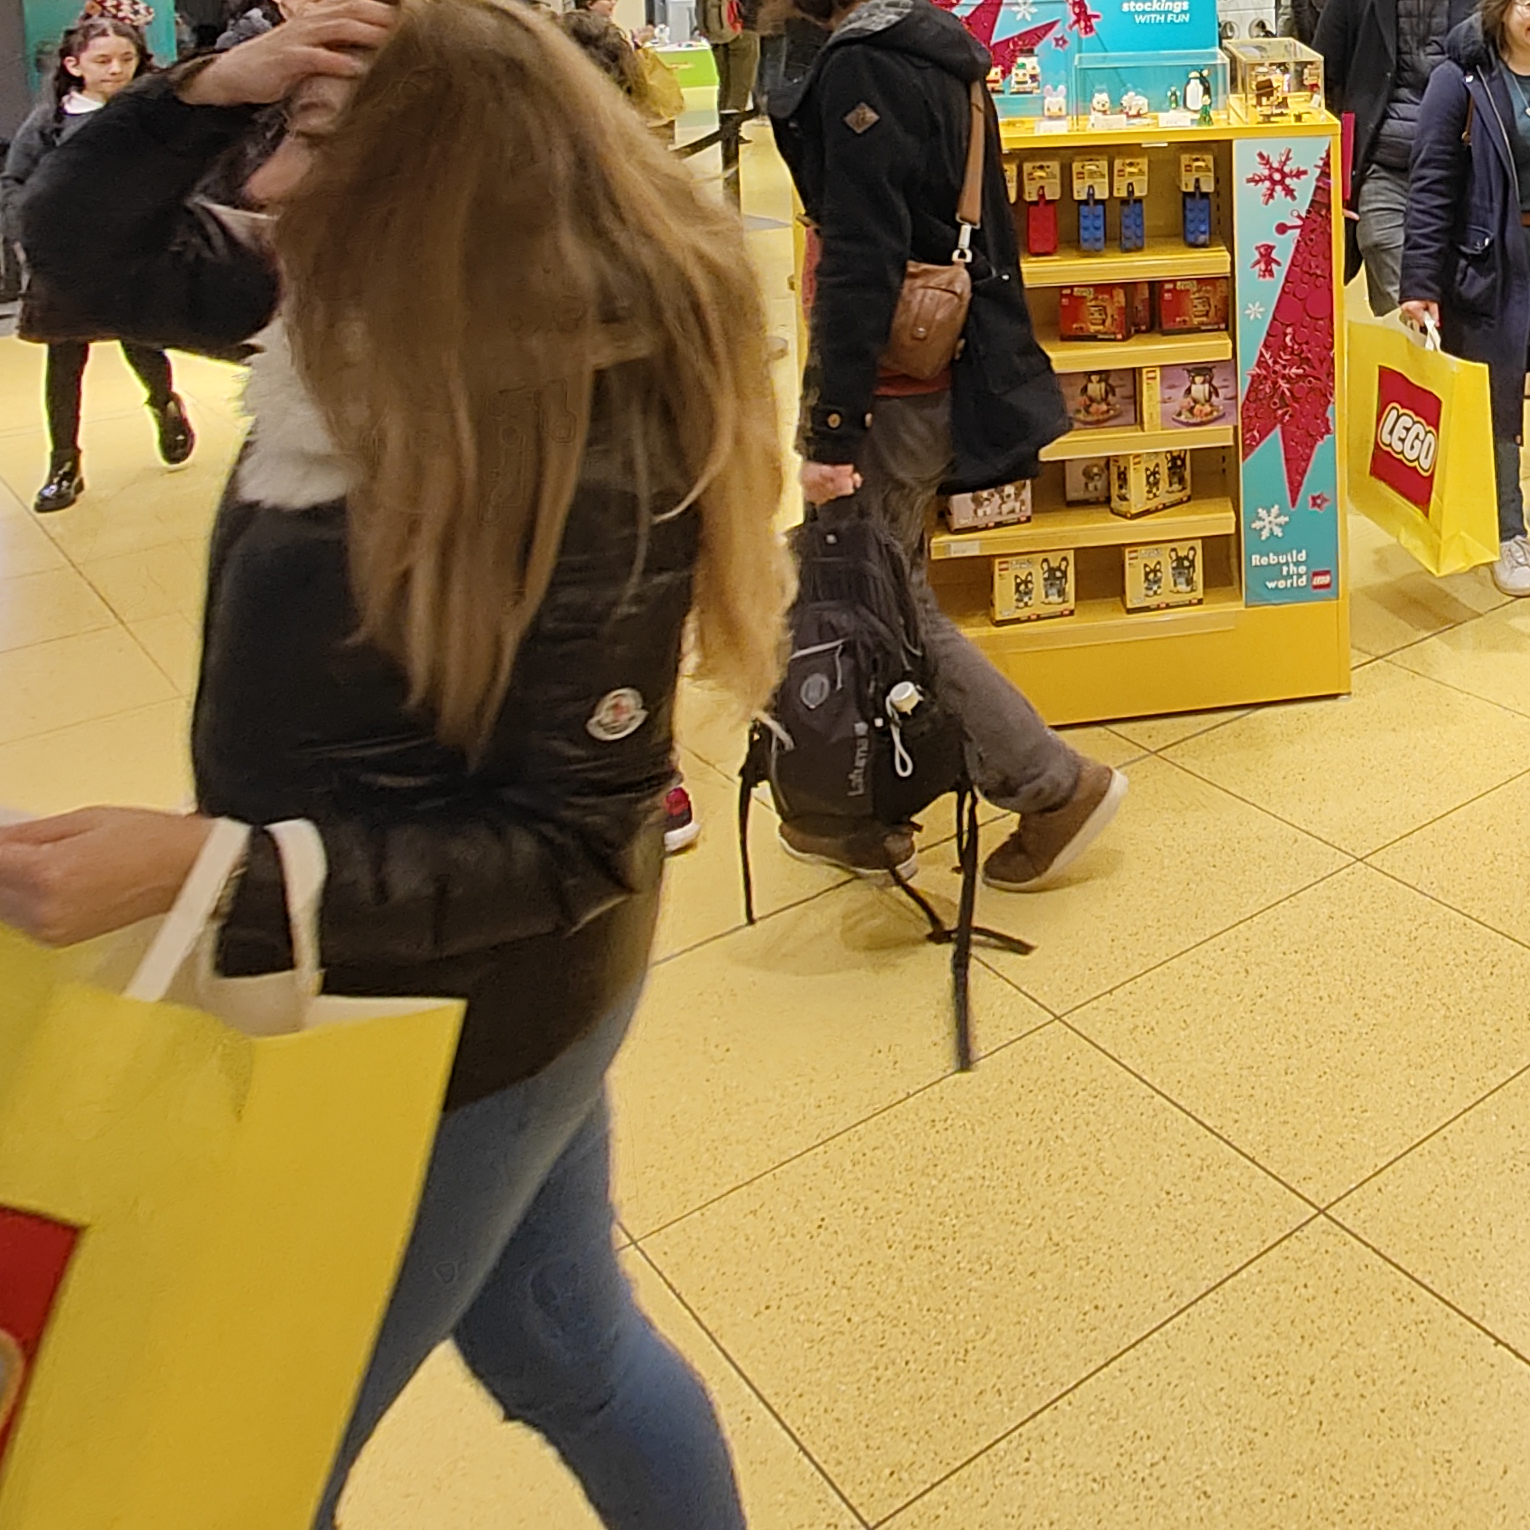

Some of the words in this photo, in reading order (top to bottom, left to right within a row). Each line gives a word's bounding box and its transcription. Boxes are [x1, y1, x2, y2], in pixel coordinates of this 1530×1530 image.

[1121, 0, 1190, 13] stockings
[1134, 13, 1166, 24] WITH
[1167, 13, 1190, 24] FUN
[1377, 404, 1437, 474] LEGO
[1251, 549, 1307, 567] Rebuild
[1281, 562, 1307, 576] the
[1265, 575, 1307, 589] world
